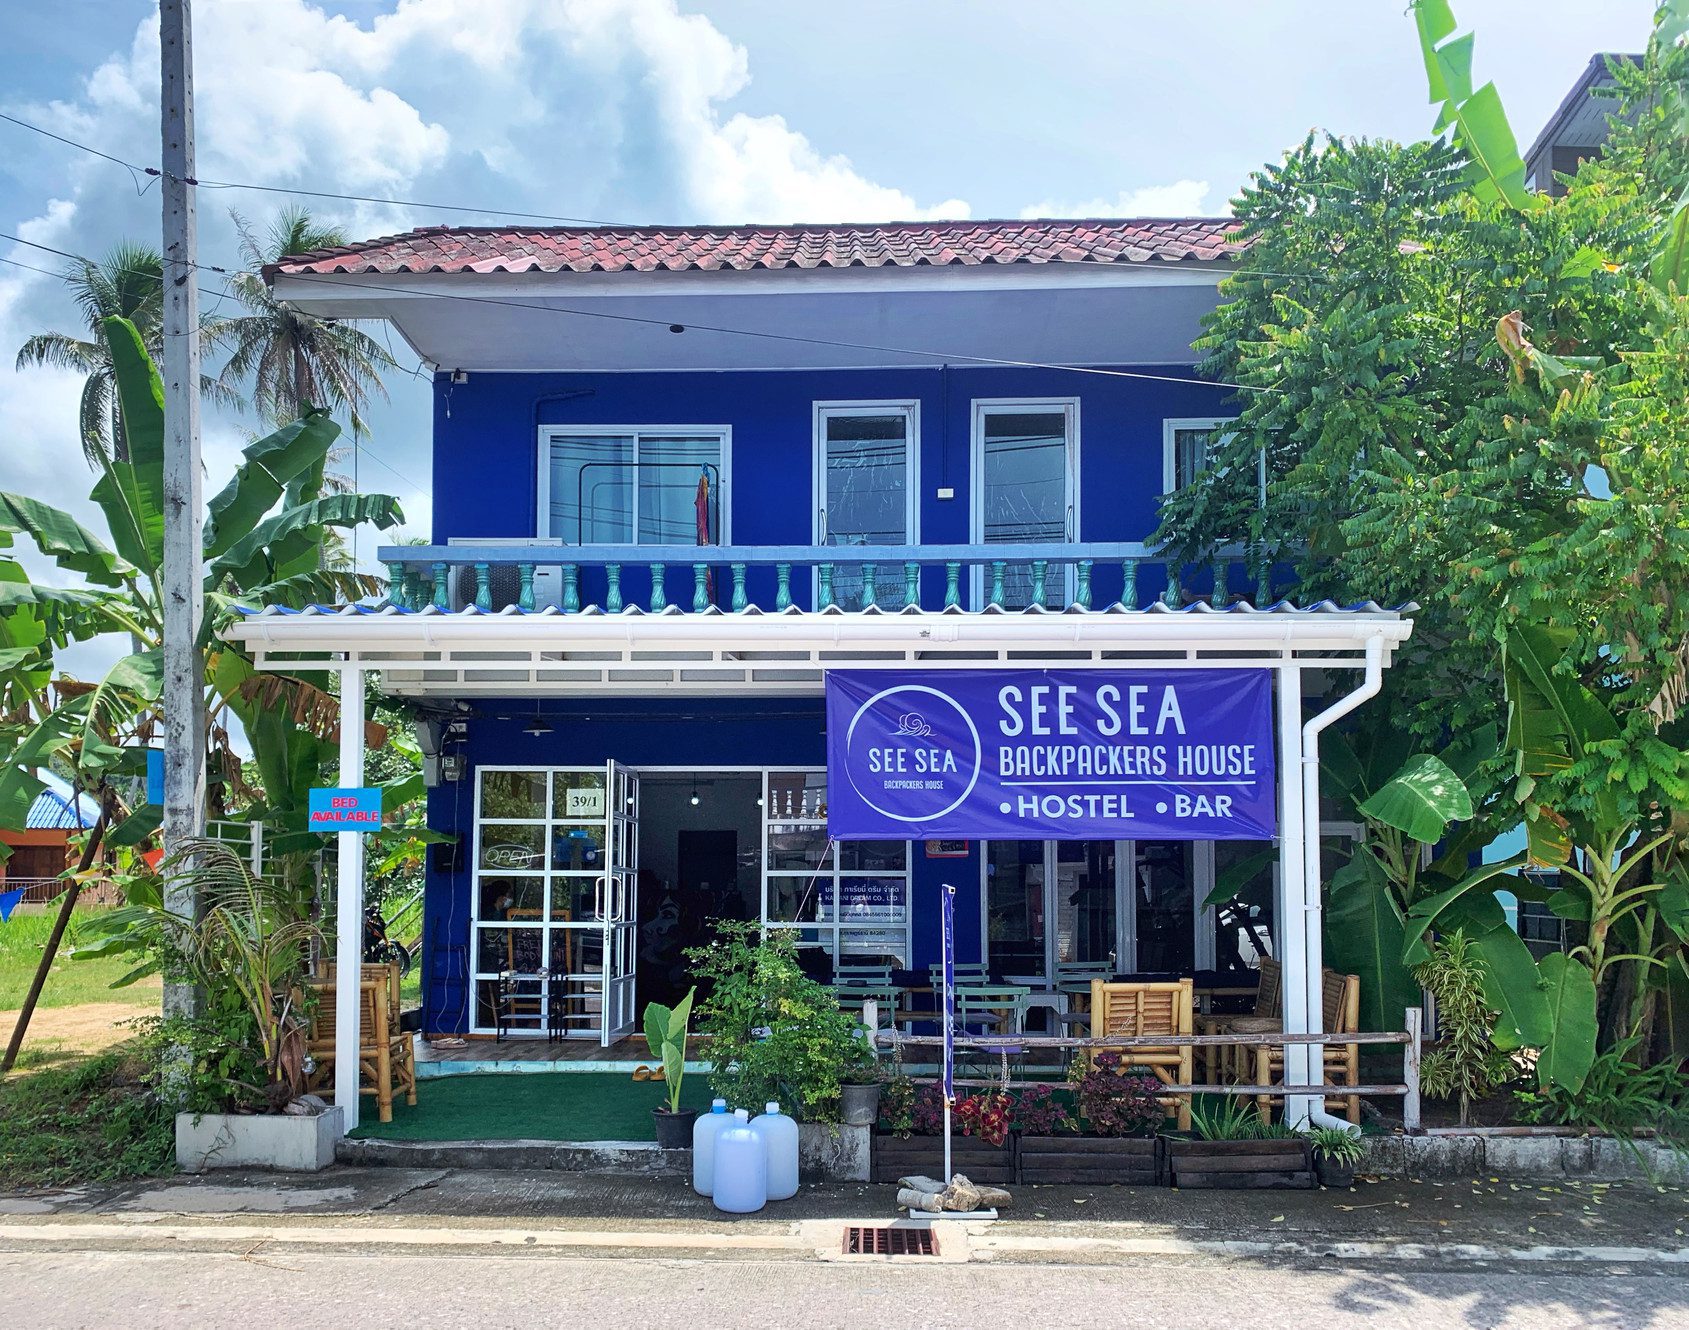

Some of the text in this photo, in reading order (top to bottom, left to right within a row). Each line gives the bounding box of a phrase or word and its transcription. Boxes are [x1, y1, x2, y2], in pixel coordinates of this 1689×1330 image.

[999, 685, 1186, 736] SEE SEA
[868, 748, 957, 773] SEE SEA
[999, 744, 1256, 776] BACKPACKERS HOUSE
[884, 780, 944, 790] BACKPACKERS HOUSE
[331, 797, 358, 808] BED
[572, 795, 598, 808] 39/1
[1018, 794, 1234, 819] HOSTEL BAR
[311, 811, 379, 822] AVAILABLE
[485, 849, 533, 864] OPEN
